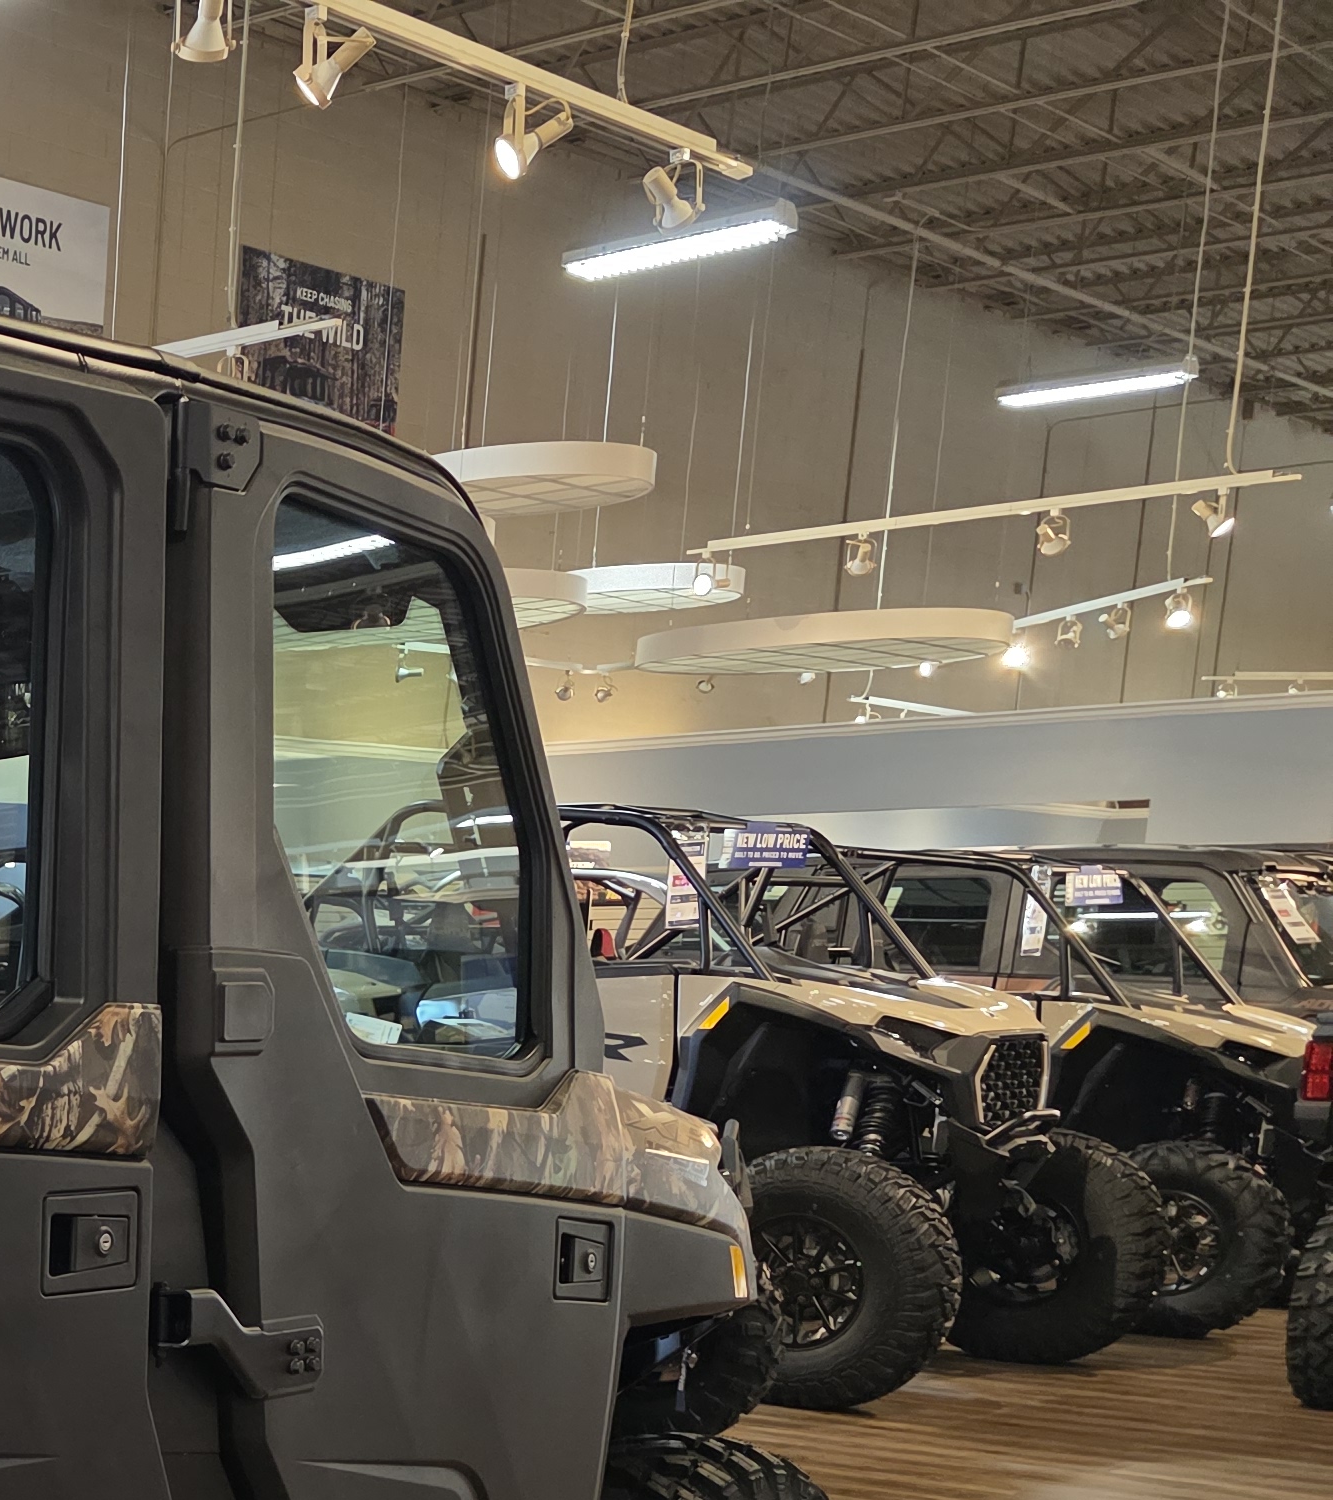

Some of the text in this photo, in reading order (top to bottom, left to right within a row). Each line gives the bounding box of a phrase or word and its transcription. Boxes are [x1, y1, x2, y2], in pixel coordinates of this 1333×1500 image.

[11, 249, 31, 266] ALL
[296, 286, 352, 313] KEEP CHASING
[736, 832, 808, 849] NEW LOW PRICE
